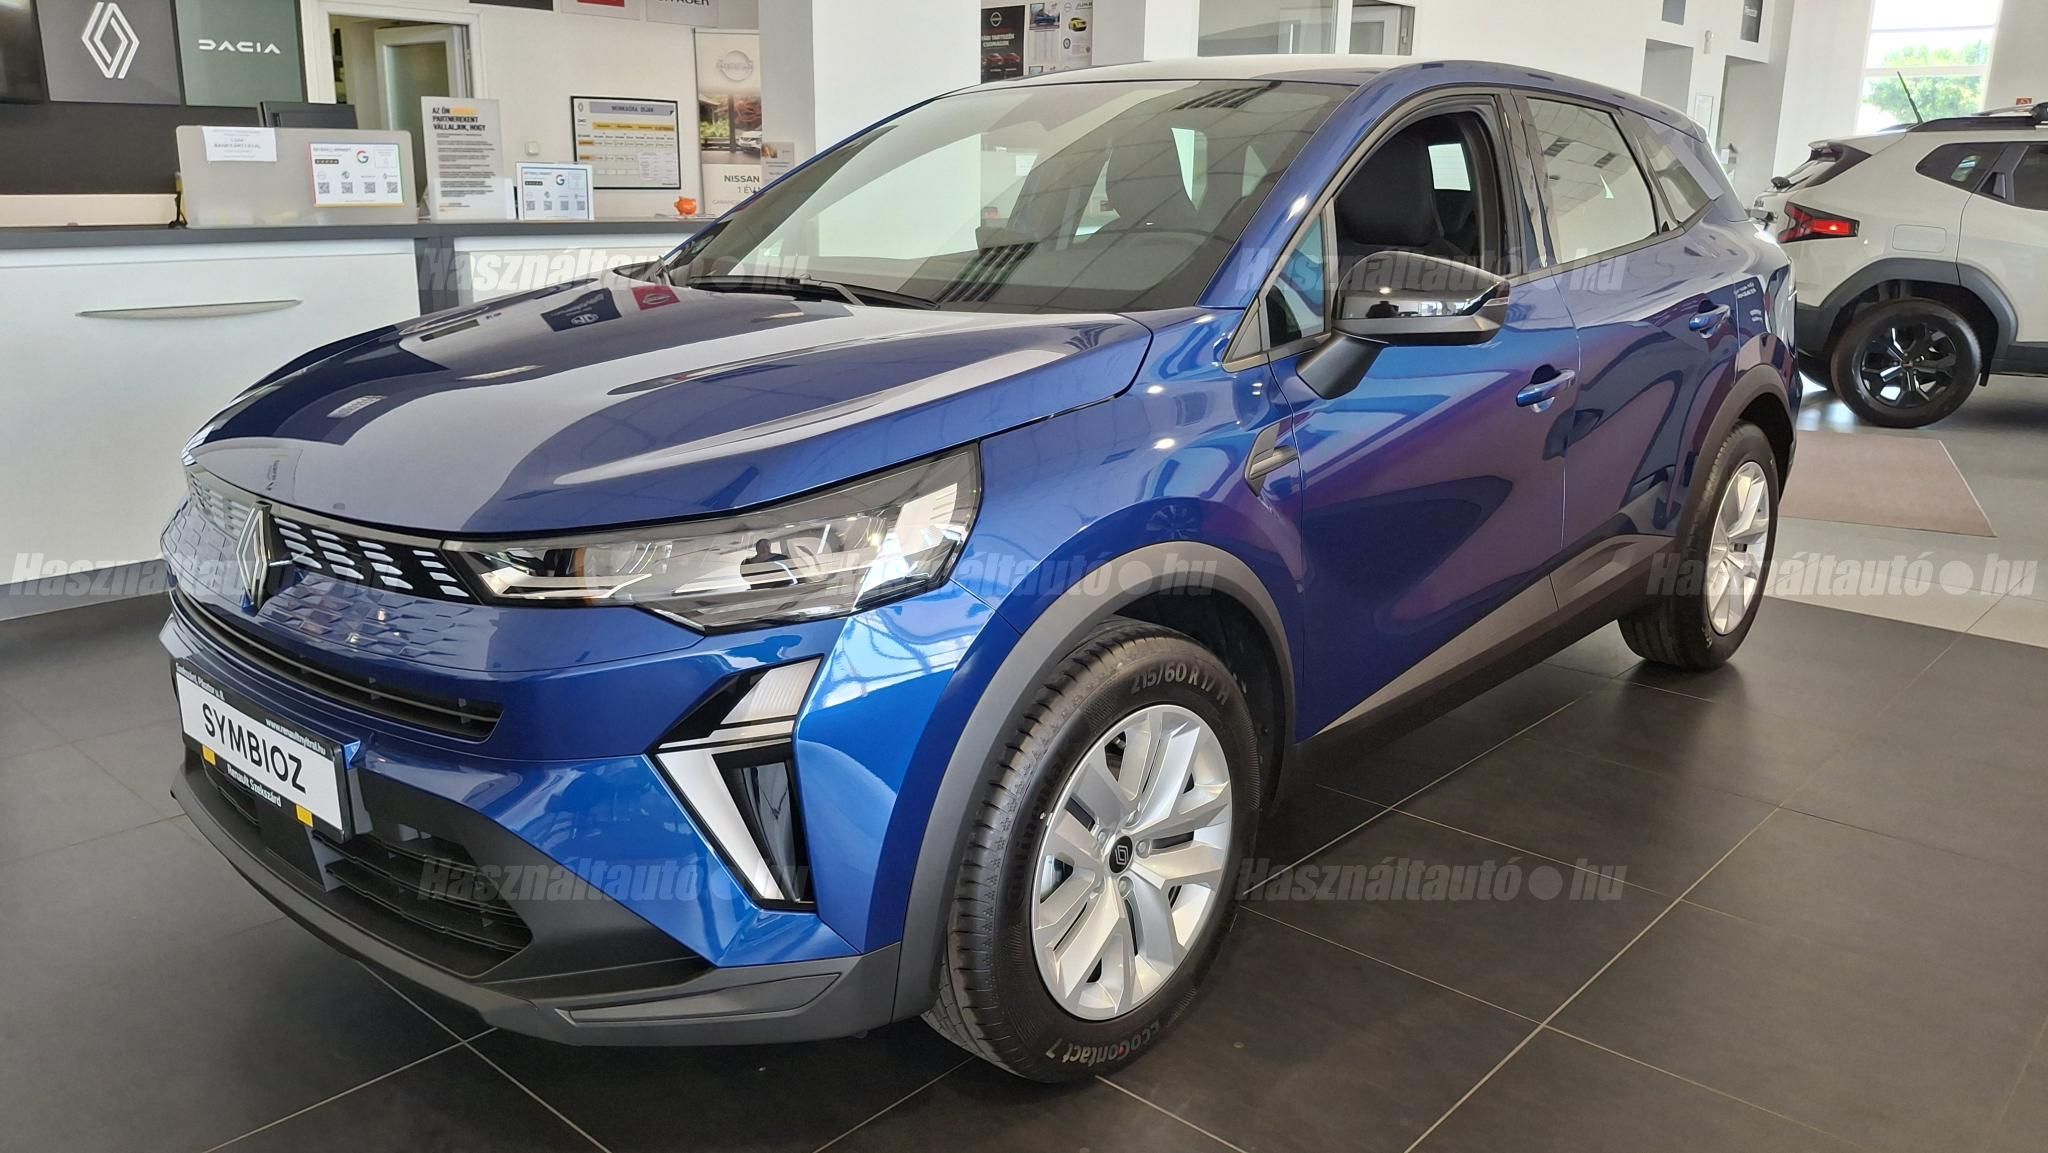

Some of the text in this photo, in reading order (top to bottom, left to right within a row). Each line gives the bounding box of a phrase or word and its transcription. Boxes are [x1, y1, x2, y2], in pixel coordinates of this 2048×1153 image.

[198, 39, 281, 54] DACIA
[724, 175, 760, 183] NISSAN
[202, 703, 306, 794] SYMBIOZ
